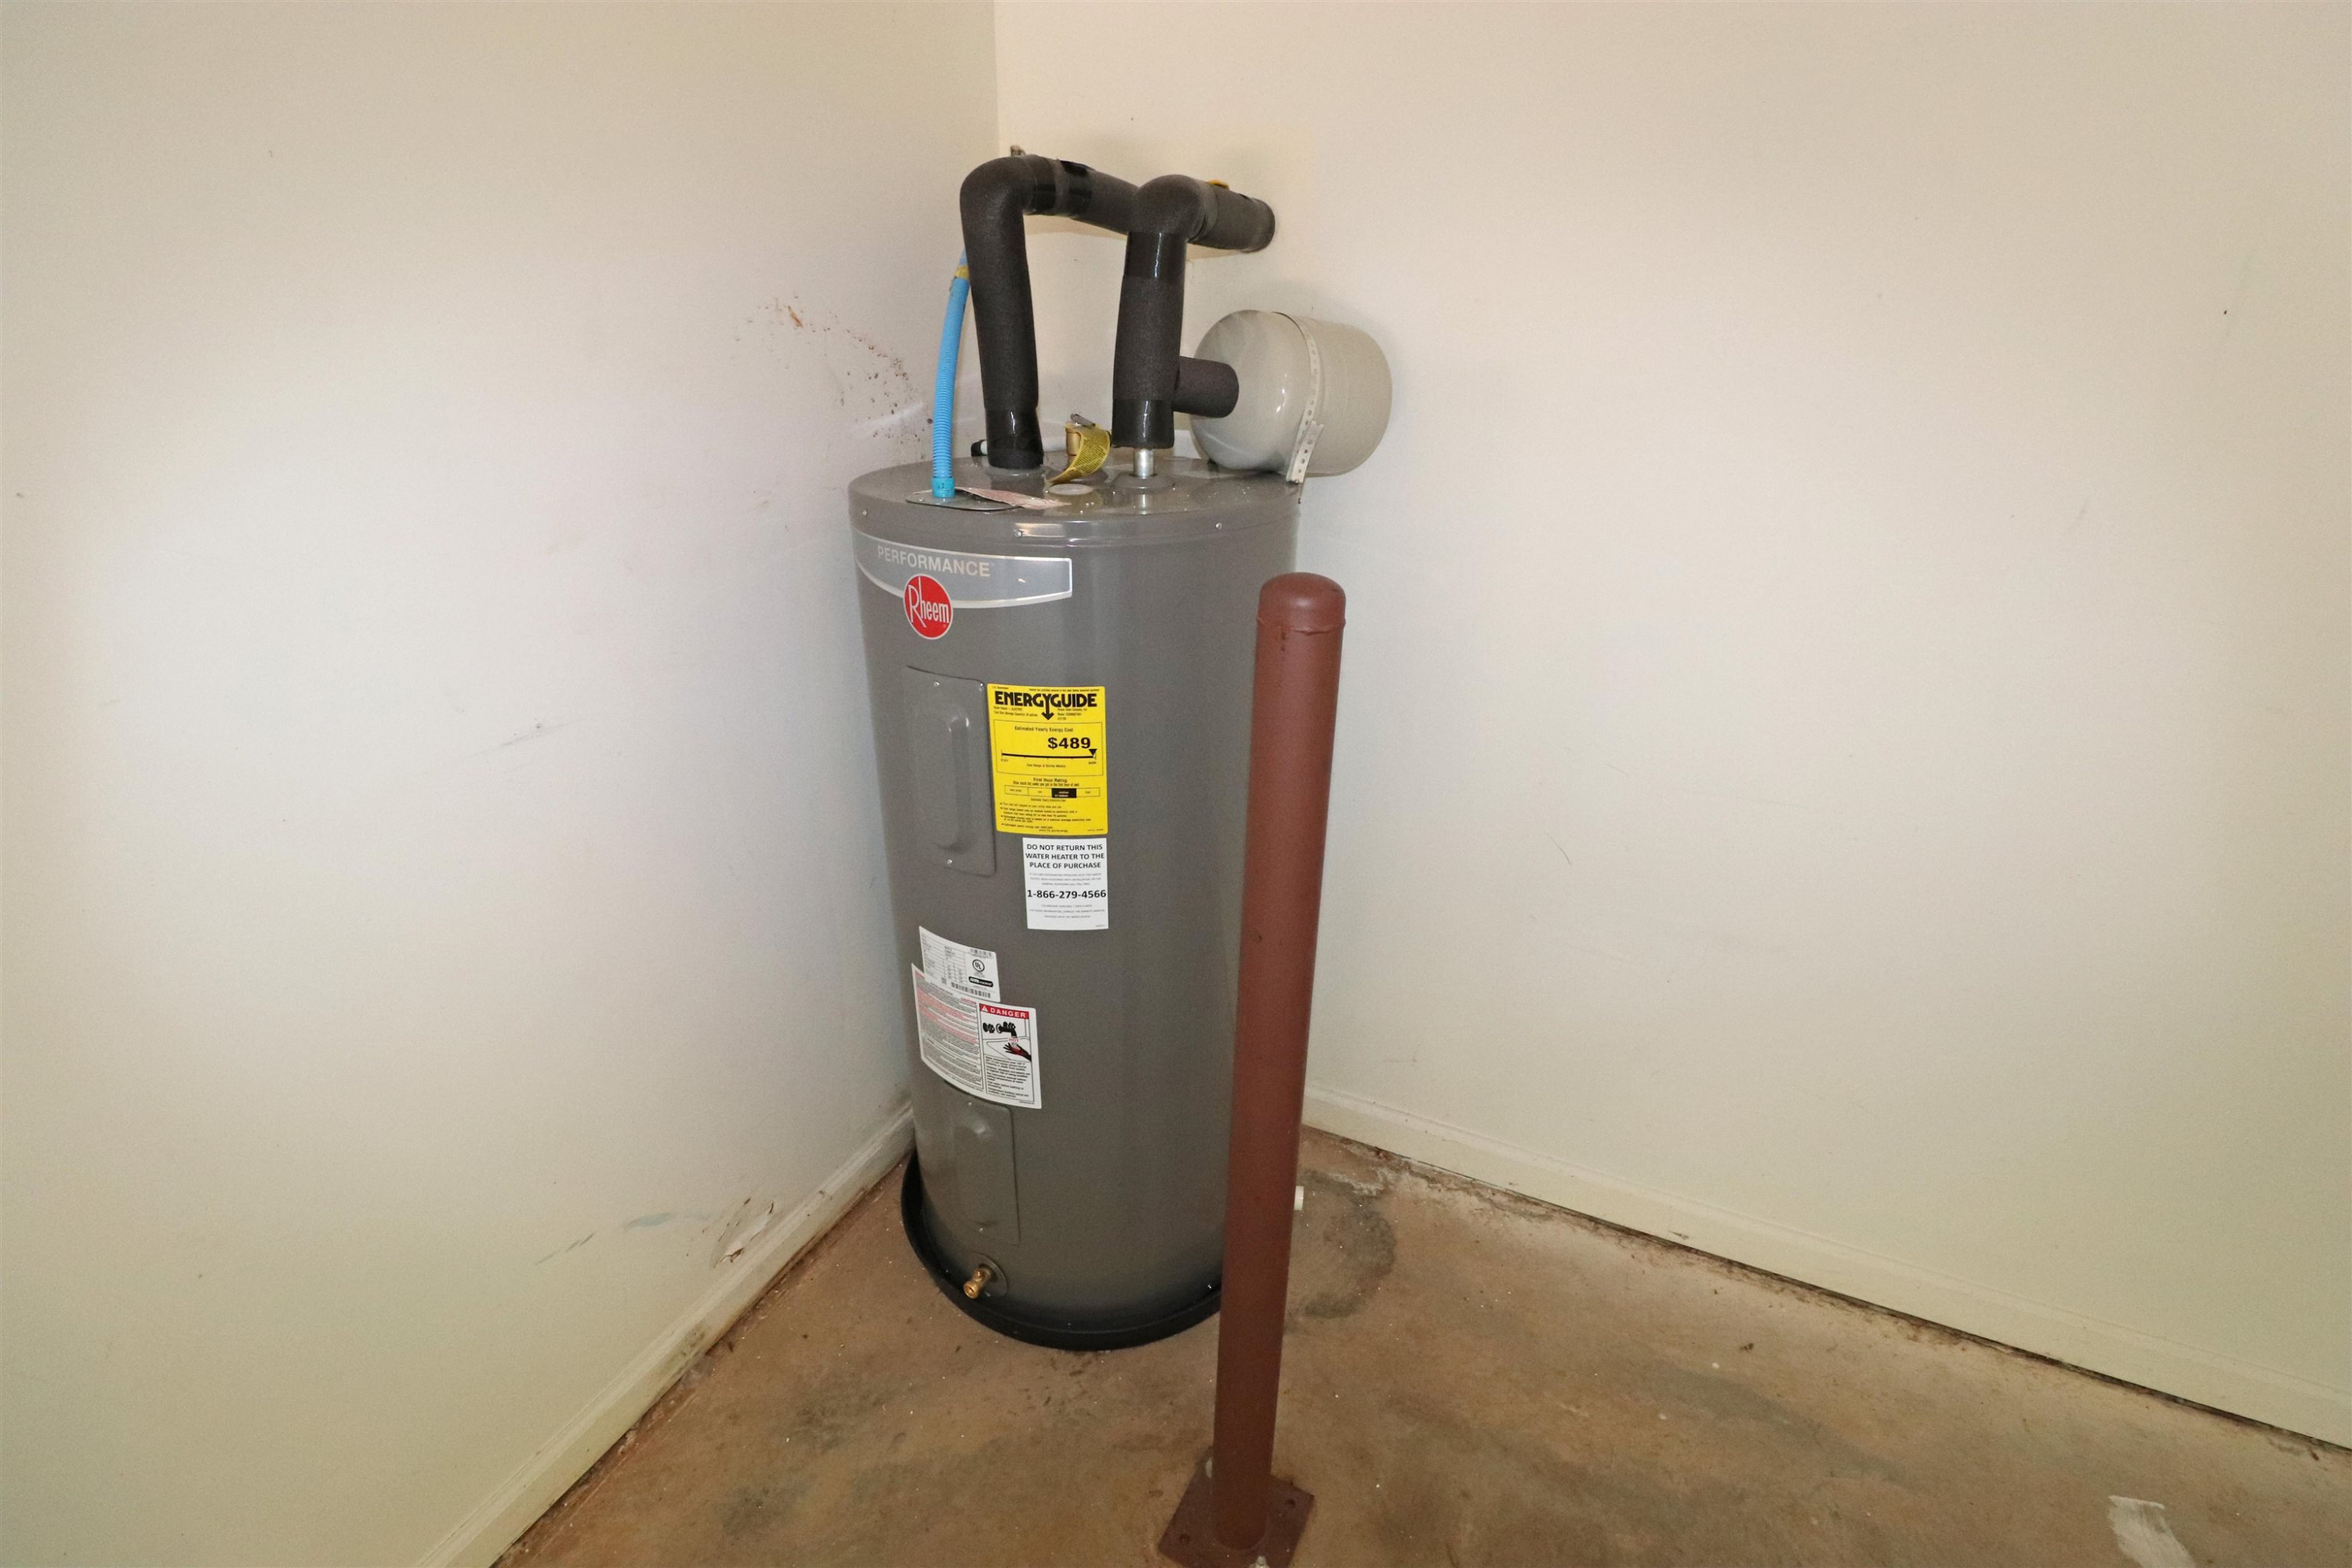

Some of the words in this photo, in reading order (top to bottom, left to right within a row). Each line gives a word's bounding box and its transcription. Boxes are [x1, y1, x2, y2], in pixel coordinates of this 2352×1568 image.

[878, 545, 990, 577] PERFORMANCE
[908, 576, 949, 628] Rheem
[994, 691, 1098, 707] ENERGYGUIDE
[1047, 736, 1091, 750] $489
[1027, 889, 1106, 898] 1-866-279-4566
[990, 1007, 1025, 1018] DANGER
